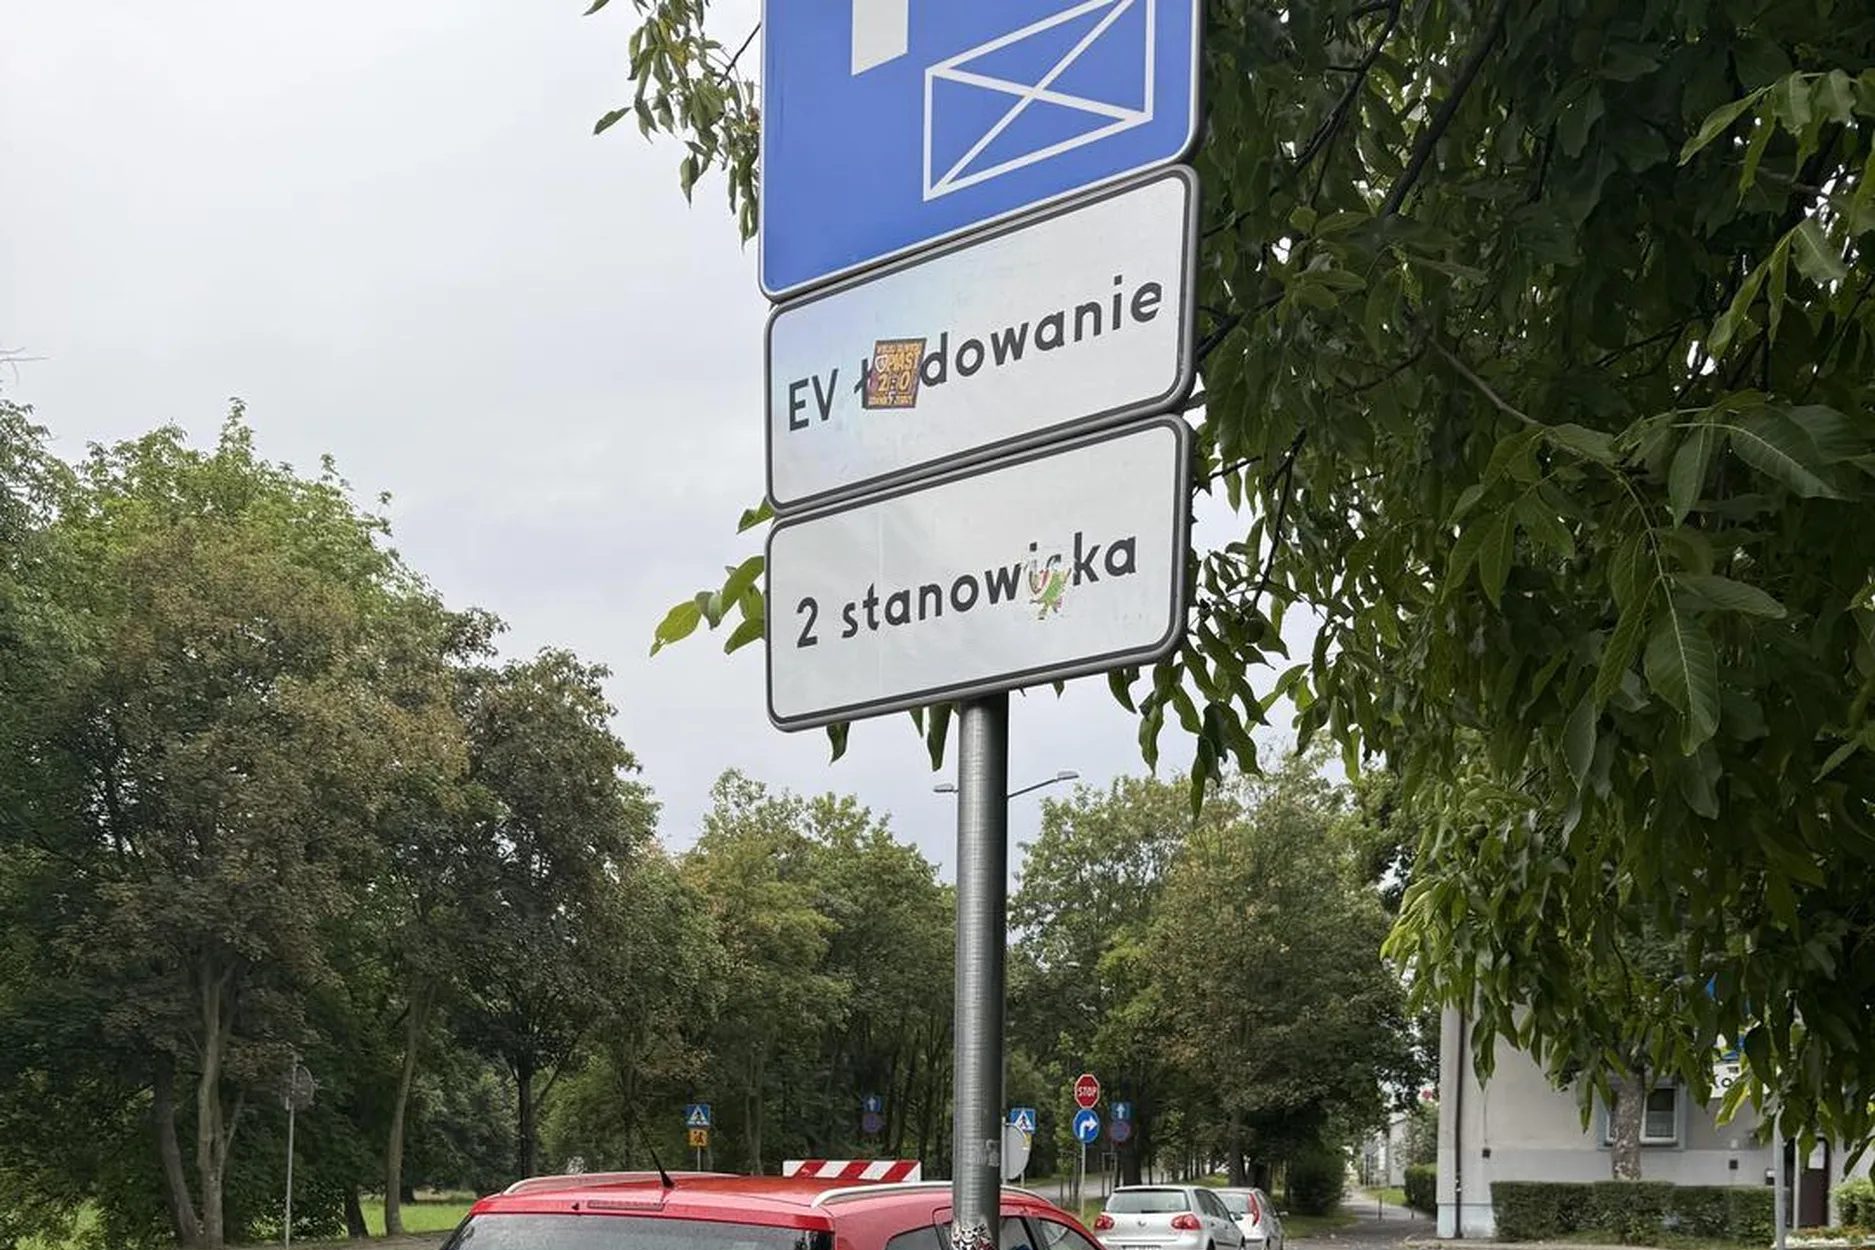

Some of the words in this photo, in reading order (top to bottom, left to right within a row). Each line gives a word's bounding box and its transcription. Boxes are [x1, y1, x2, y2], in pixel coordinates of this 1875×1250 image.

[789, 368, 839, 432] EV
[853, 274, 1163, 410] łdowanie
[795, 596, 819, 648] 2
[1077, 1086, 1097, 1097] STOP
